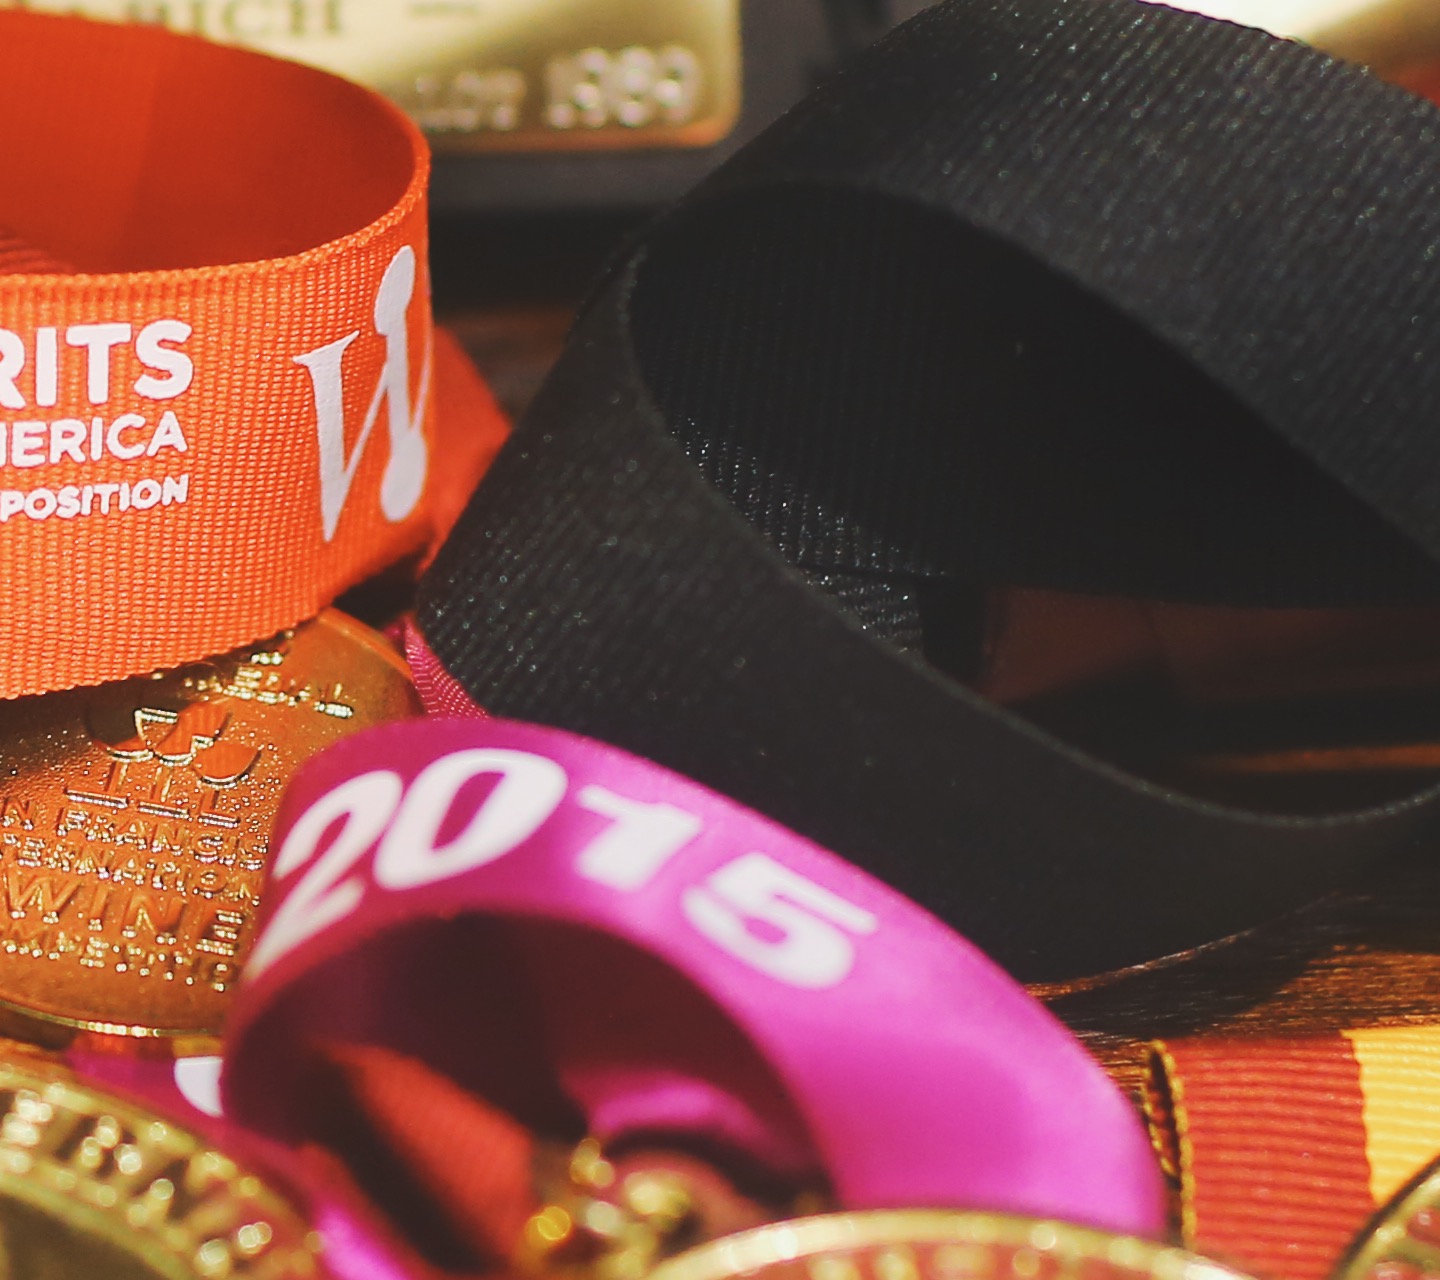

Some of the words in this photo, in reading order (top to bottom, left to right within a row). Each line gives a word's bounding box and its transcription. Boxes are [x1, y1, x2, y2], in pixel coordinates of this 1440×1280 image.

[54, 808, 270, 872] FRANCIS
[246, 746, 880, 994] 2015
[0, 868, 246, 958] WINE
